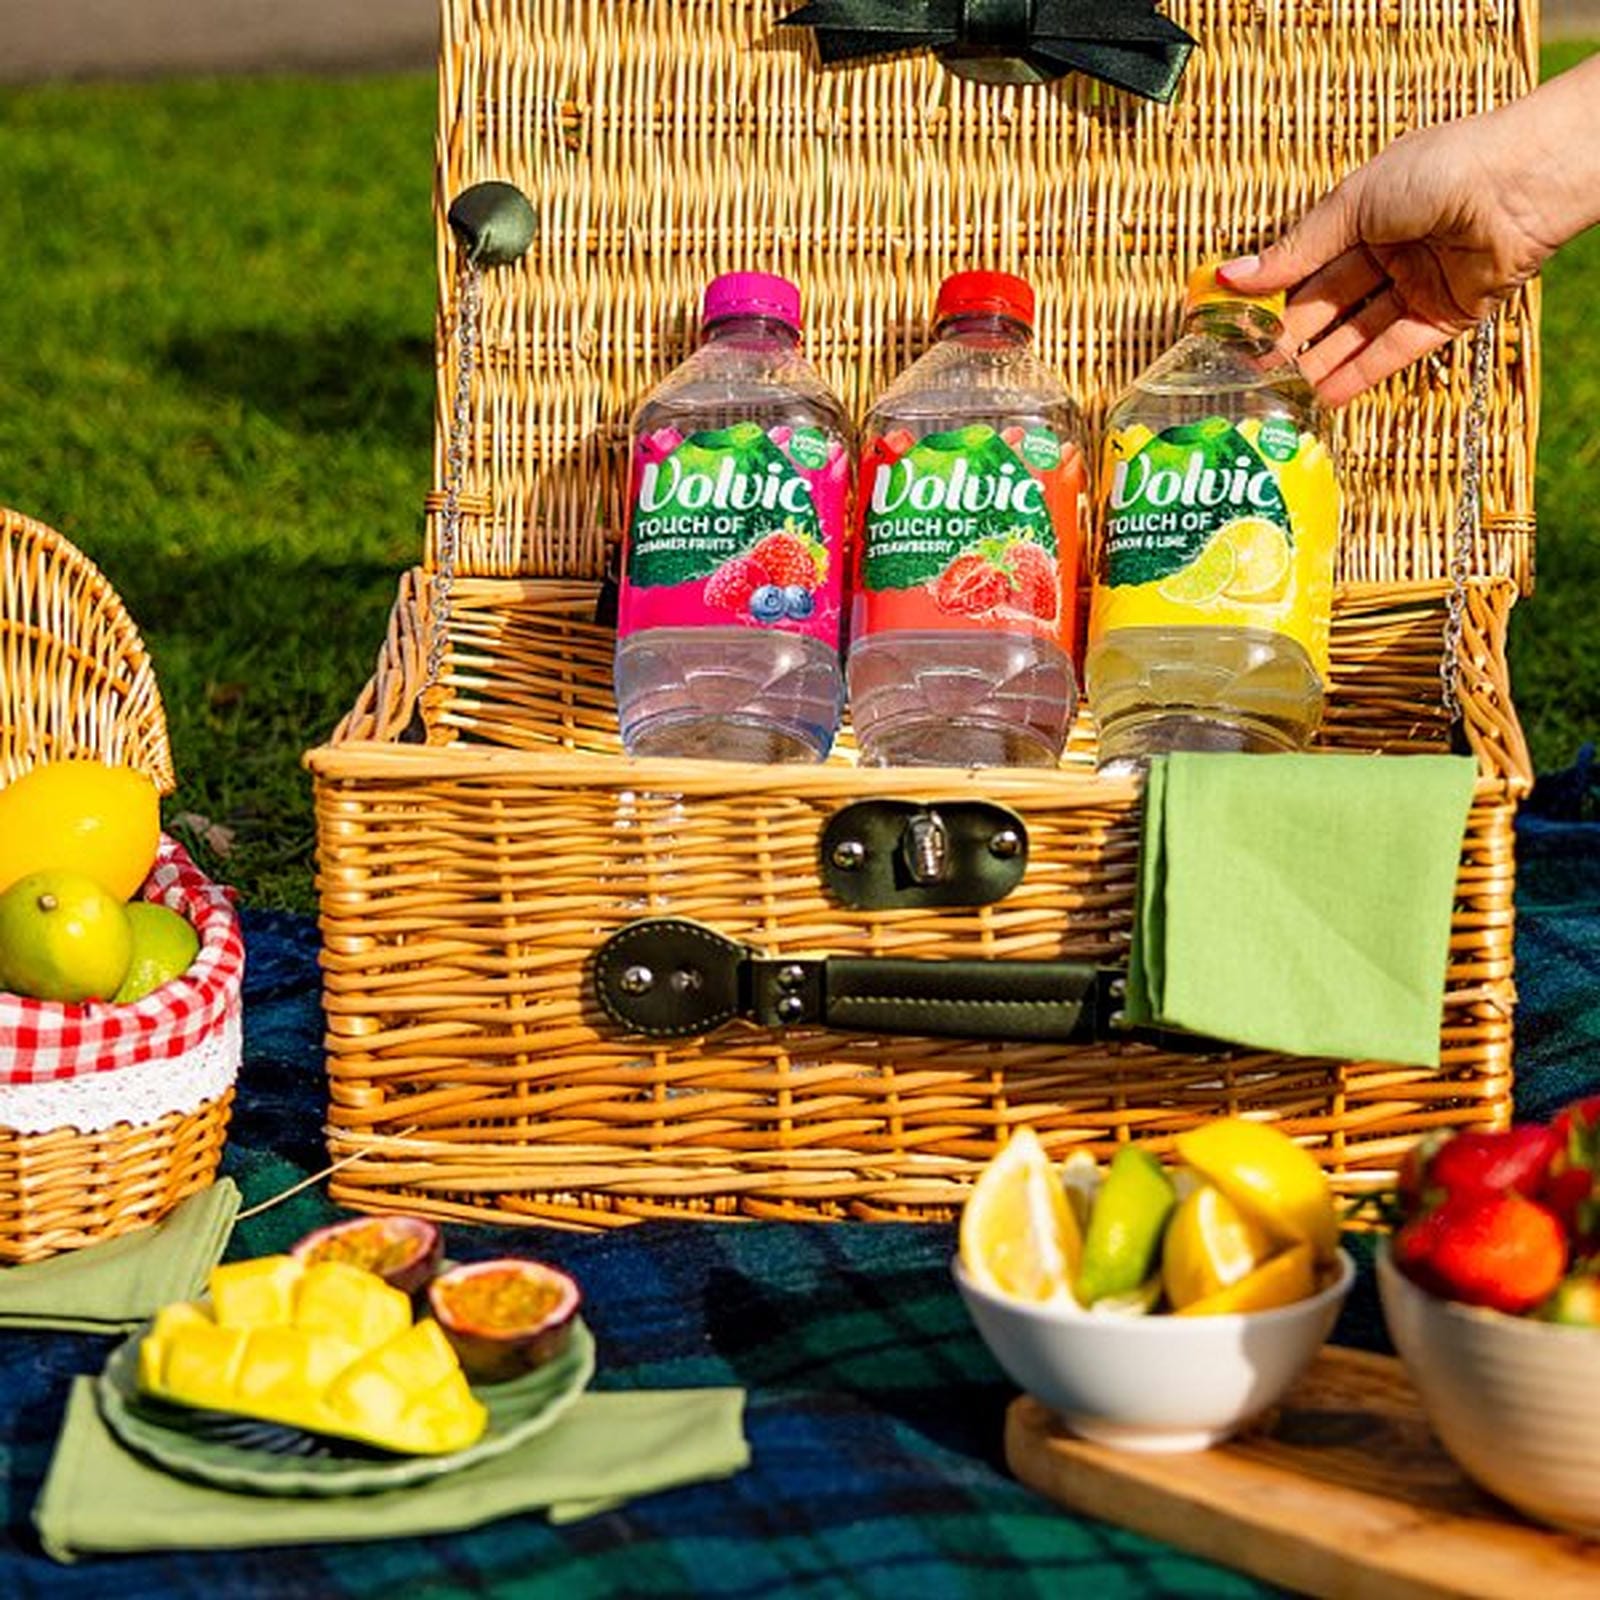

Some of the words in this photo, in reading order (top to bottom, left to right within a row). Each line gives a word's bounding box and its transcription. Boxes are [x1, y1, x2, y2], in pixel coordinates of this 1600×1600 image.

[639, 456, 813, 513] Volvic
[871, 457, 1046, 515] Volvic
[1110, 452, 1281, 509] Volvic
[637, 516, 709, 539] TOUCH
[714, 516, 745, 535] OF
[869, 517, 942, 541] TOUCH
[946, 517, 977, 536] OF
[1106, 512, 1177, 537] TOUCH
[1181, 511, 1213, 530] OF
[688, 537, 736, 551] FRUITS
[868, 539, 954, 558] STRAWBERRY
